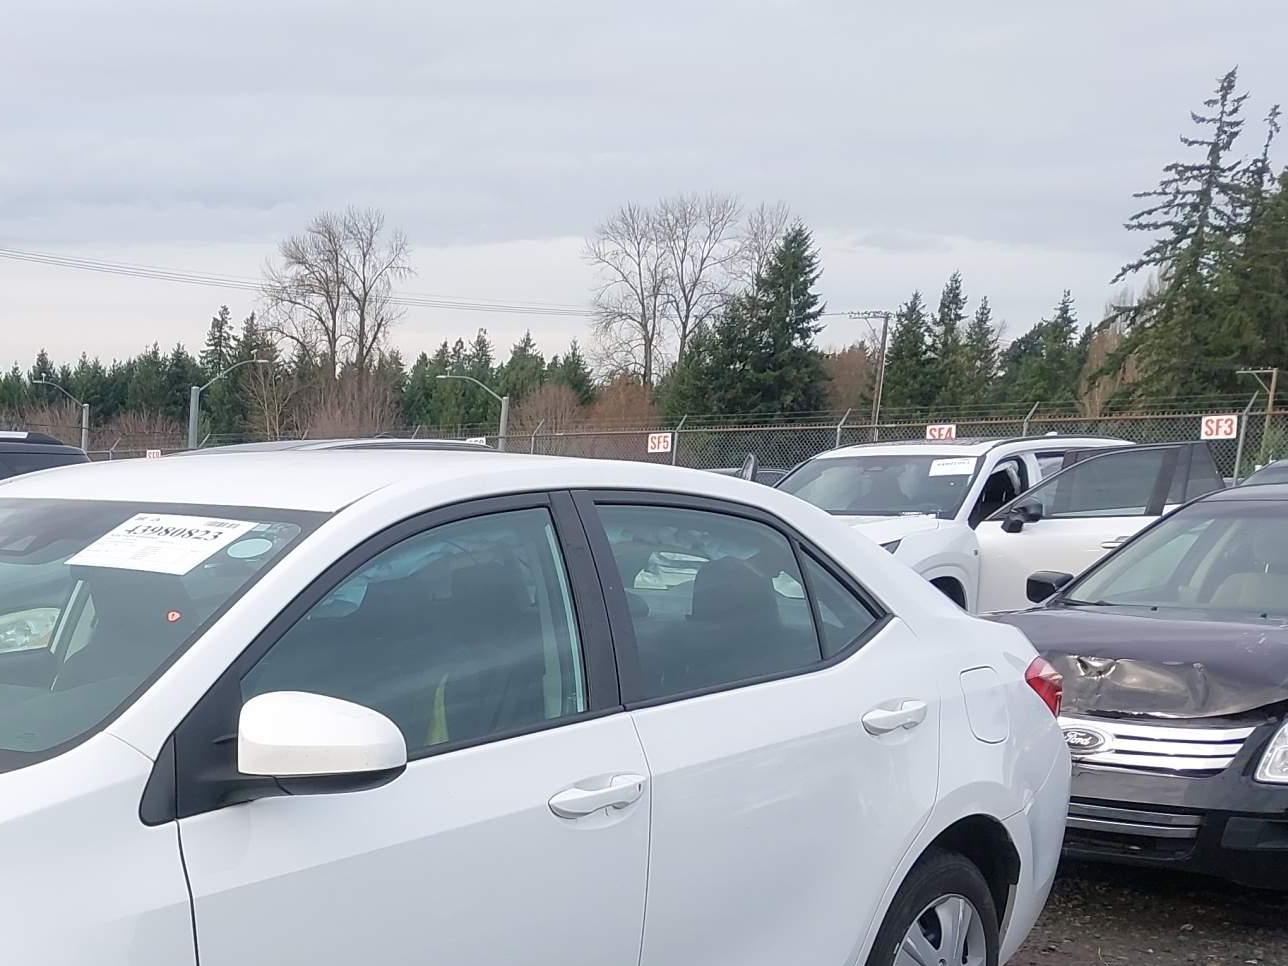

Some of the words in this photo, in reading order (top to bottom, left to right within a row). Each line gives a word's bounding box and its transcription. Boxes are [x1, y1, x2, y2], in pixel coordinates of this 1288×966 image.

[1204, 418, 1234, 436] SF3
[650, 435, 669, 450] SF5
[125, 524, 223, 541] 43980823
[1064, 731, 1093, 746] Ford
